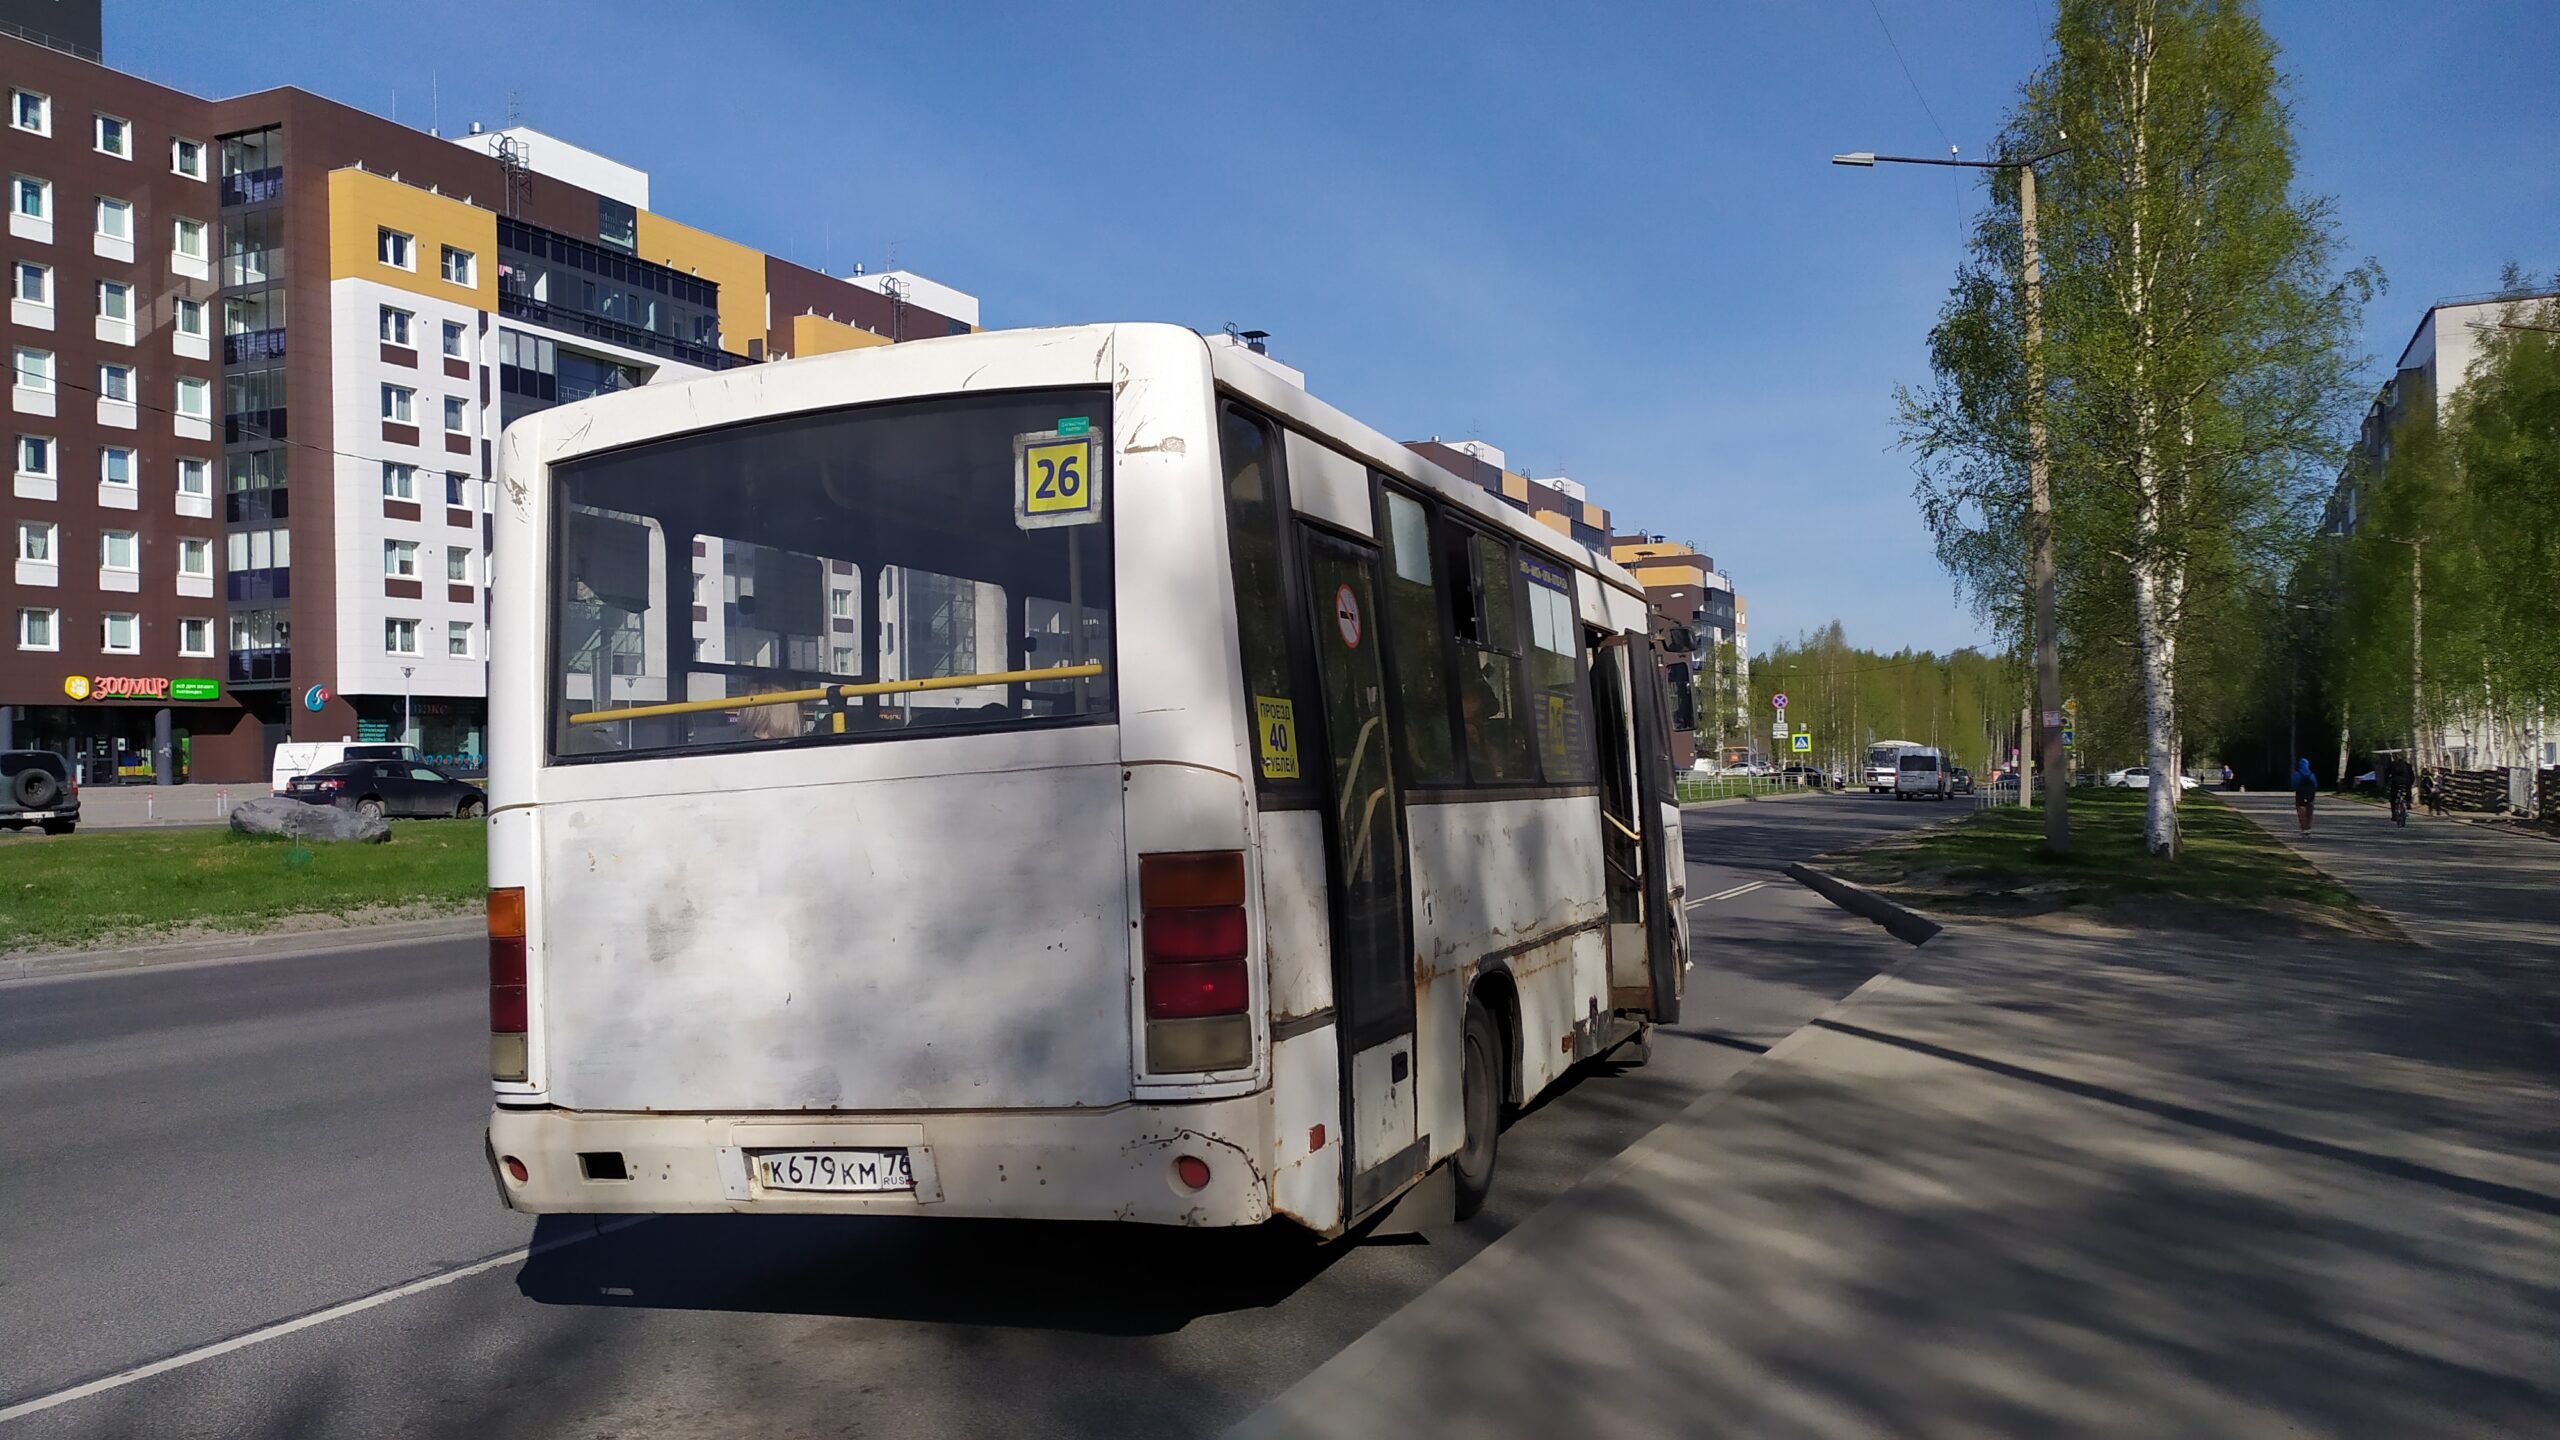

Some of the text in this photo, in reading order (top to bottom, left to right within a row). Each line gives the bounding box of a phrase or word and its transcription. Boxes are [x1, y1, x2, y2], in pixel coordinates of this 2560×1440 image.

[1036, 456, 1080, 499] 26
[1260, 702, 1291, 721] ПРОЕЗД
[1269, 723, 1288, 752] 40
[883, 1154, 911, 1176] 76
[884, 1176, 905, 1186] RUS
